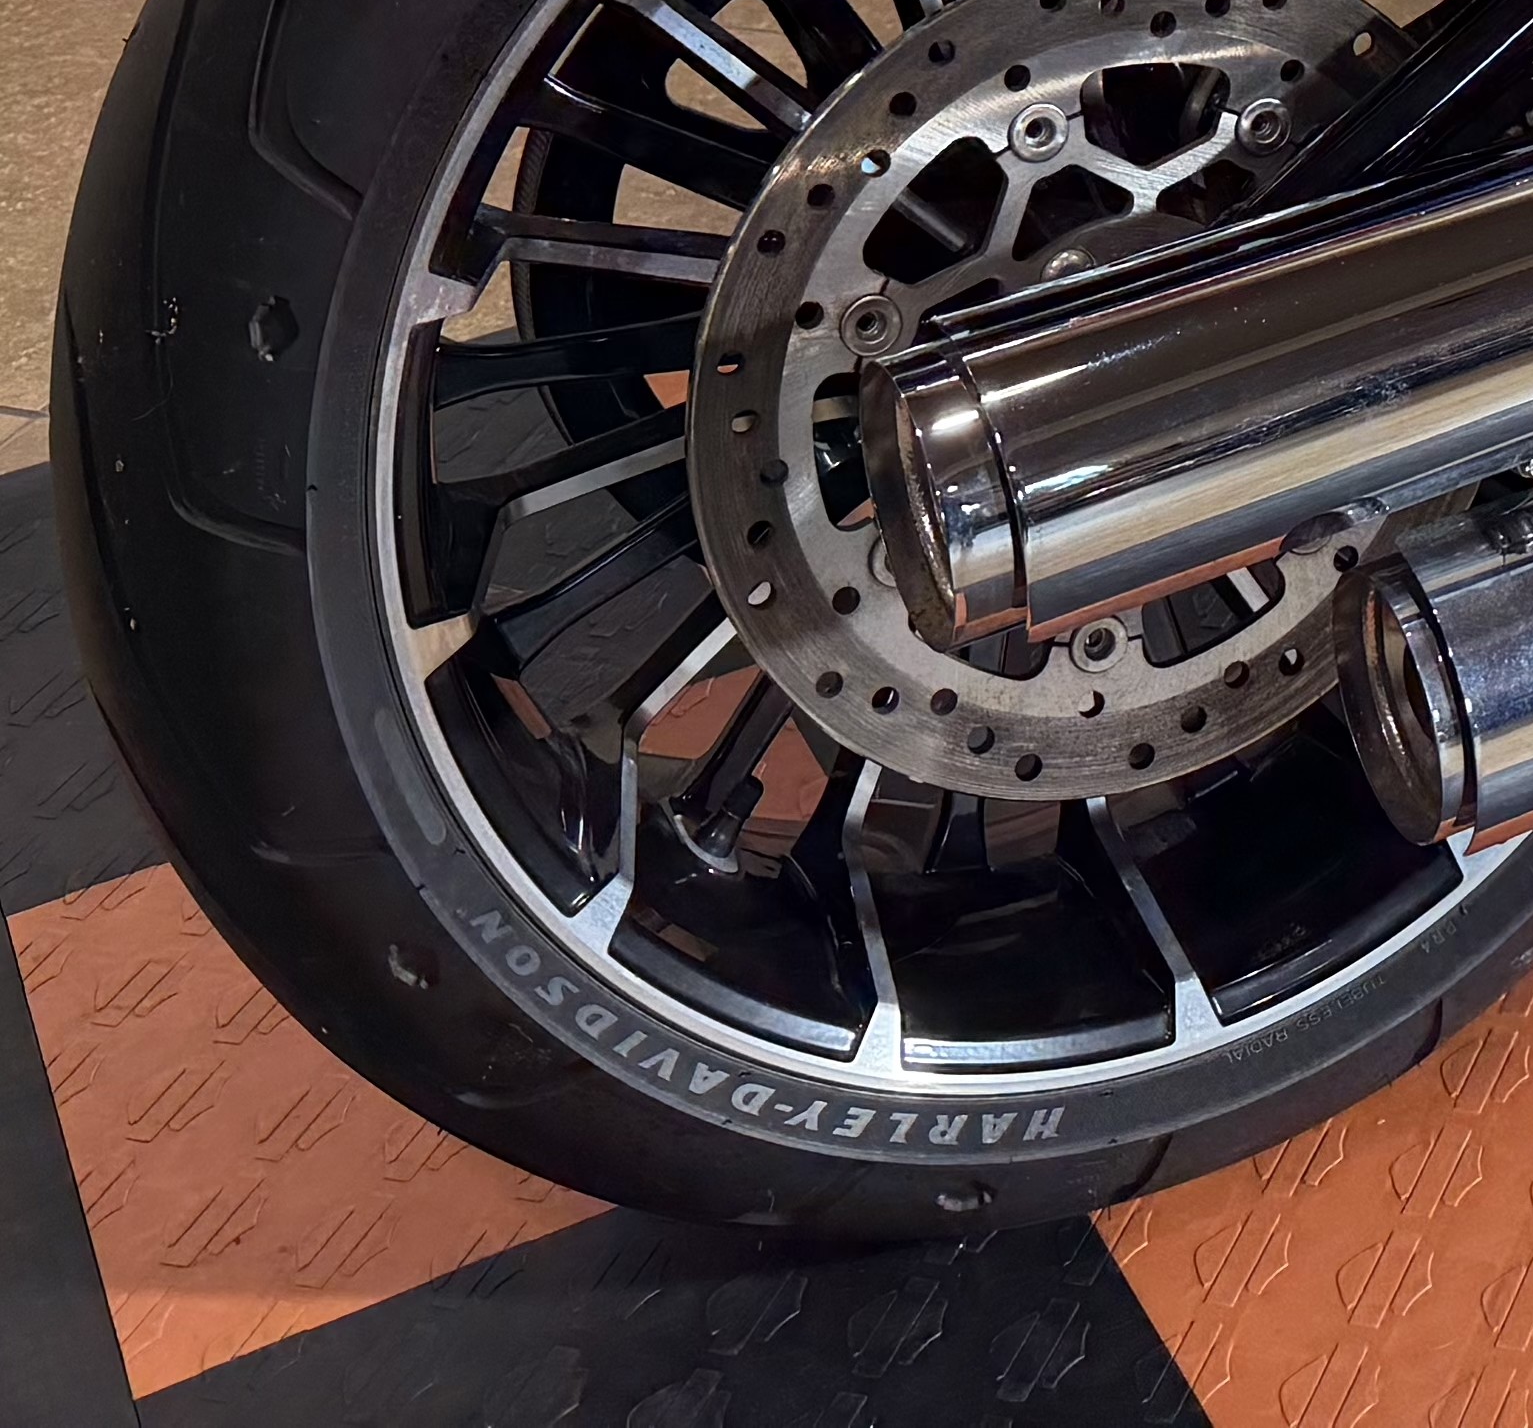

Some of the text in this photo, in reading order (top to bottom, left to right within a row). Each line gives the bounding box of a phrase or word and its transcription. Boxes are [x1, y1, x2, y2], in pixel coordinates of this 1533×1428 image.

[469, 909, 1065, 1145] HARLEY-DAVIDSON
[1221, 973, 1386, 1065] TUBELESS RADIAL
